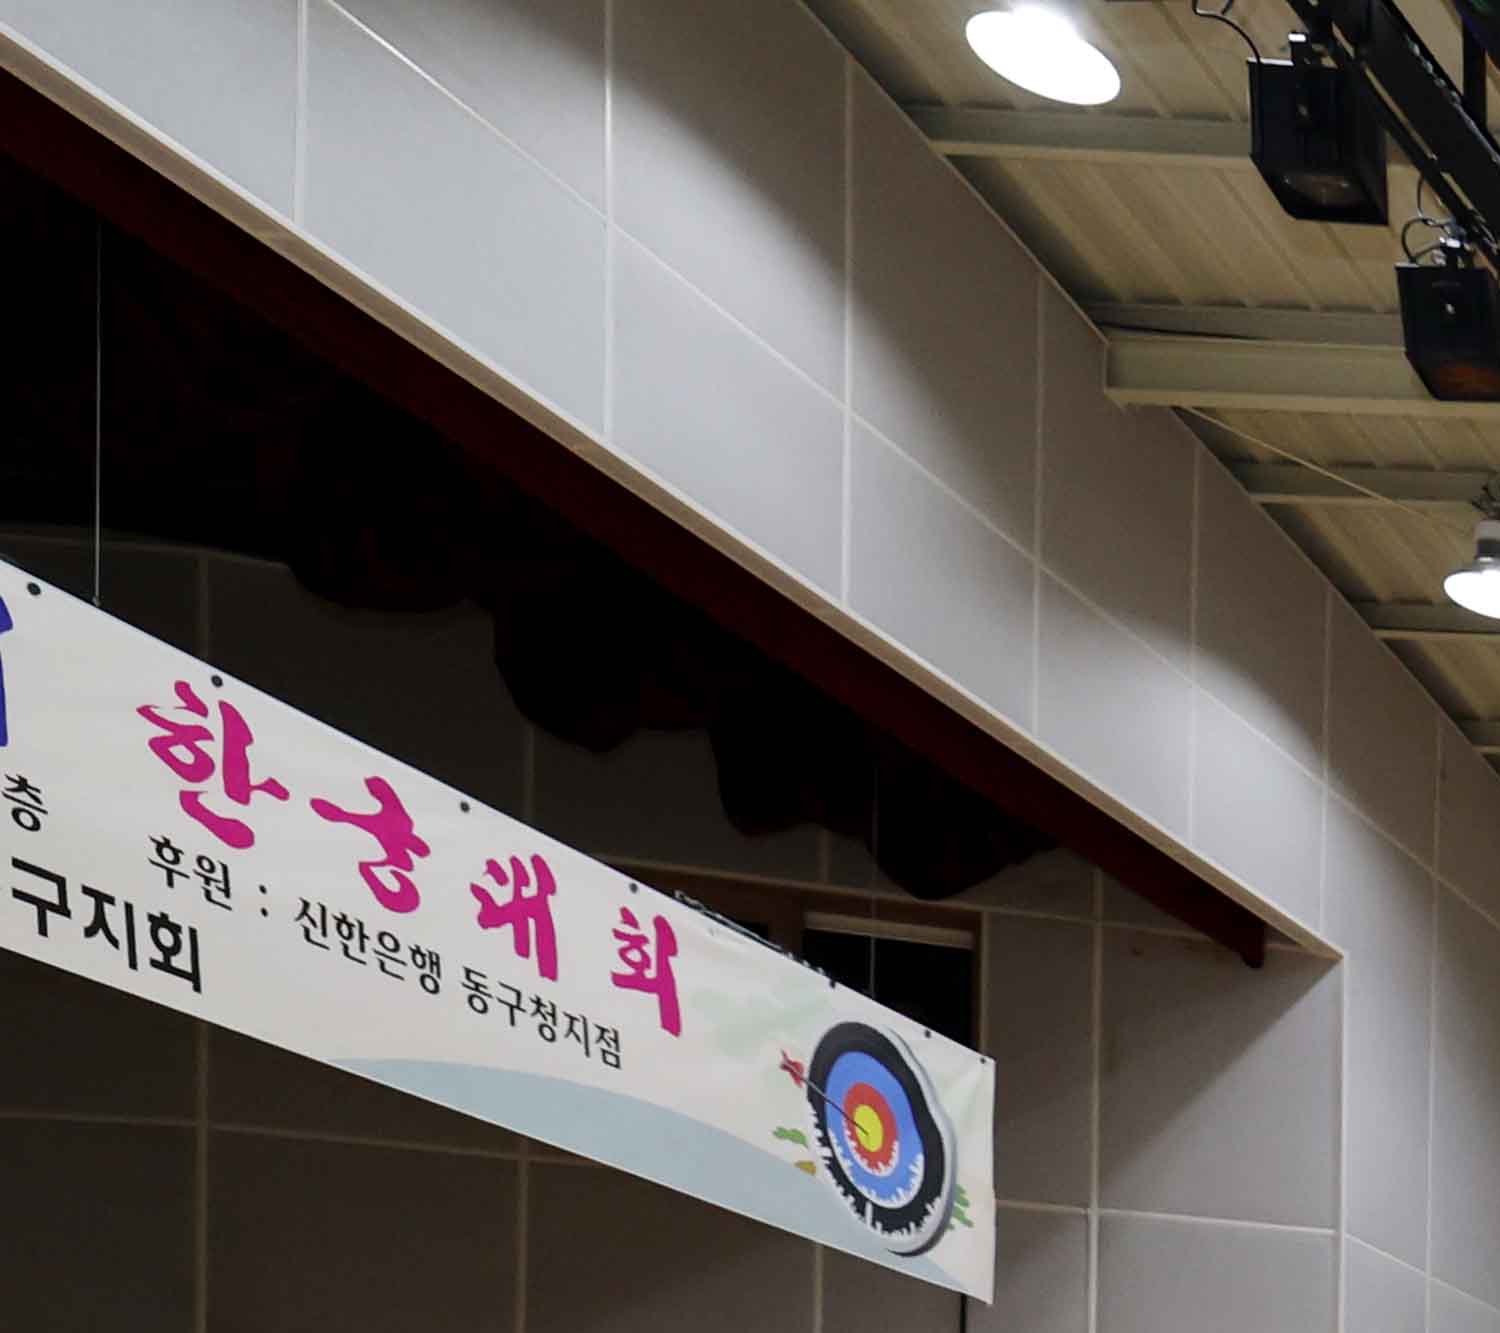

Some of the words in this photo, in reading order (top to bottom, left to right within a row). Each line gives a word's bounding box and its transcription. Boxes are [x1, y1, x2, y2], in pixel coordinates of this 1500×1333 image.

[2, 774, 48, 832] 층
[148, 834, 233, 911] 후원
[294, 896, 443, 995] 신한은행
[460, 965, 624, 1070] 동구청지점
